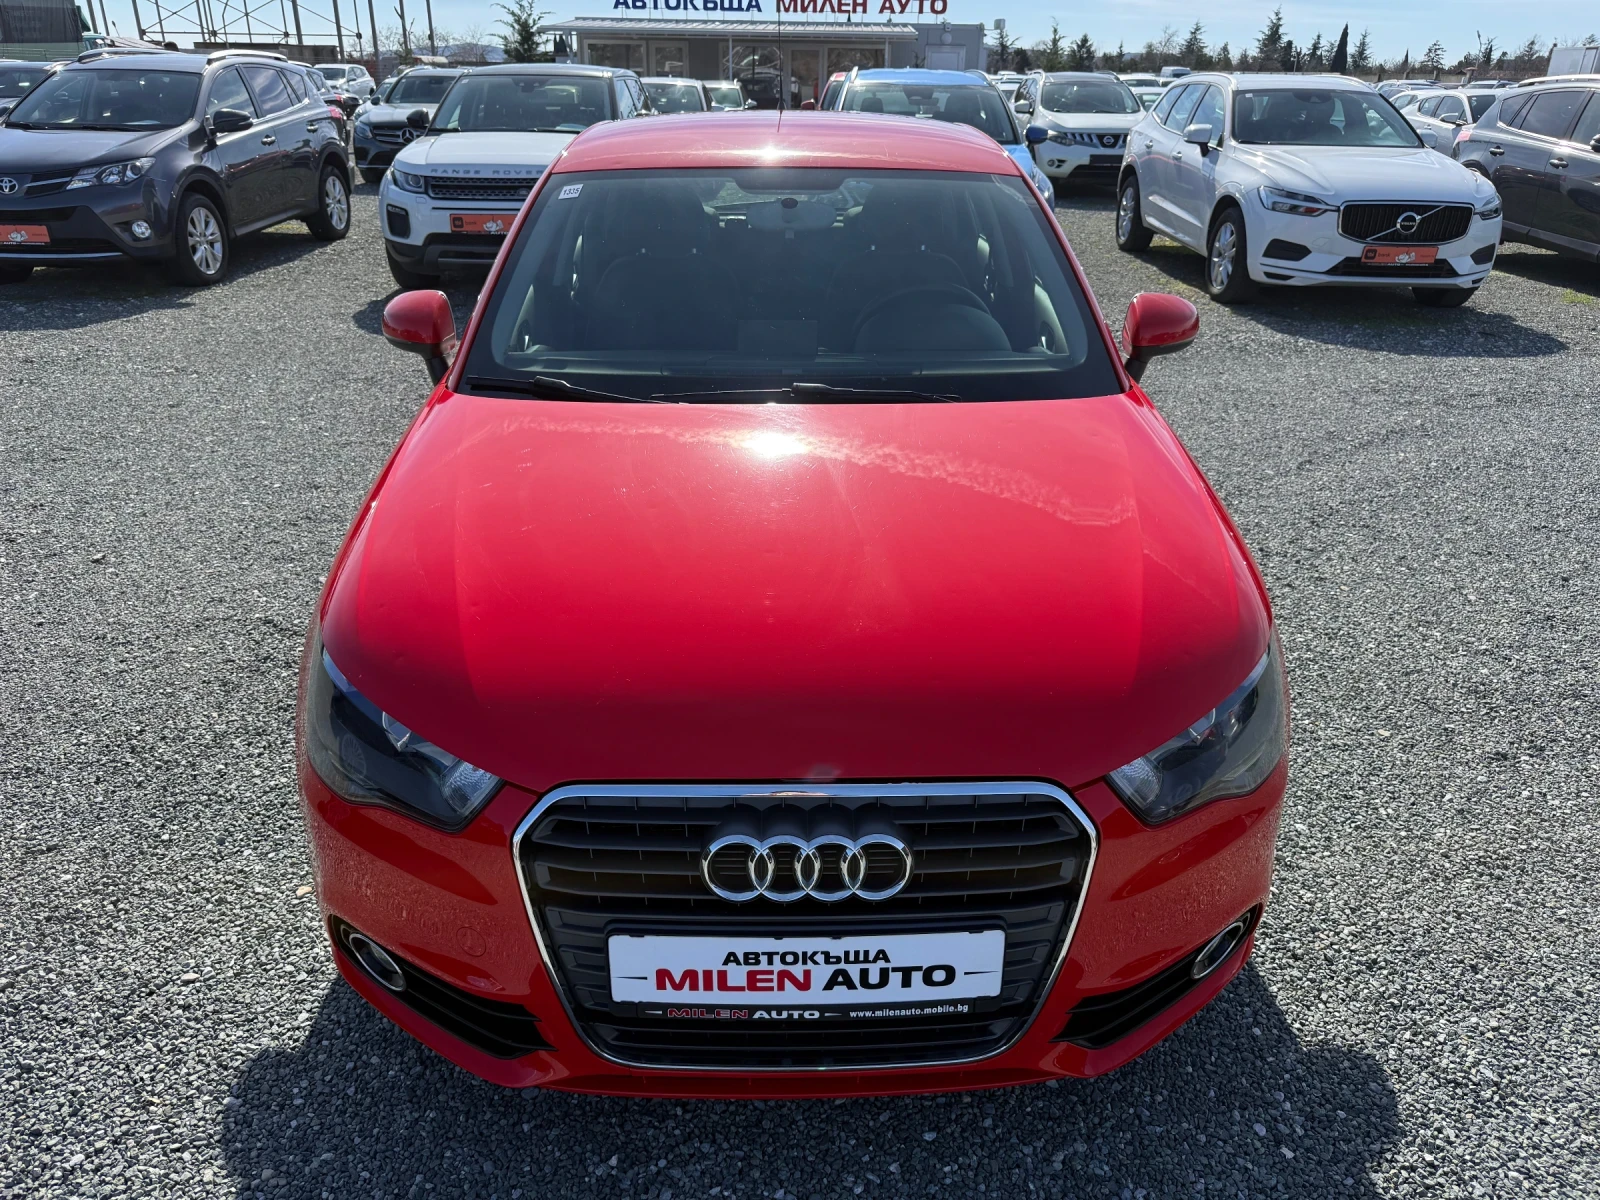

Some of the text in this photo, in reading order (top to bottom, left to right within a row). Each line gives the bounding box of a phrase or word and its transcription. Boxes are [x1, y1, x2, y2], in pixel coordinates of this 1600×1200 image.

[776, 0, 867, 13] МИЛЕН
[878, 0, 948, 14] АУТО
[563, 187, 580, 196] 1335
[721, 949, 891, 966] АВТОКЪЩА
[655, 964, 956, 992] MILEN AUTO
[667, 1003, 969, 1019] MILEN AUTO www.milenauto.mobile.bg
